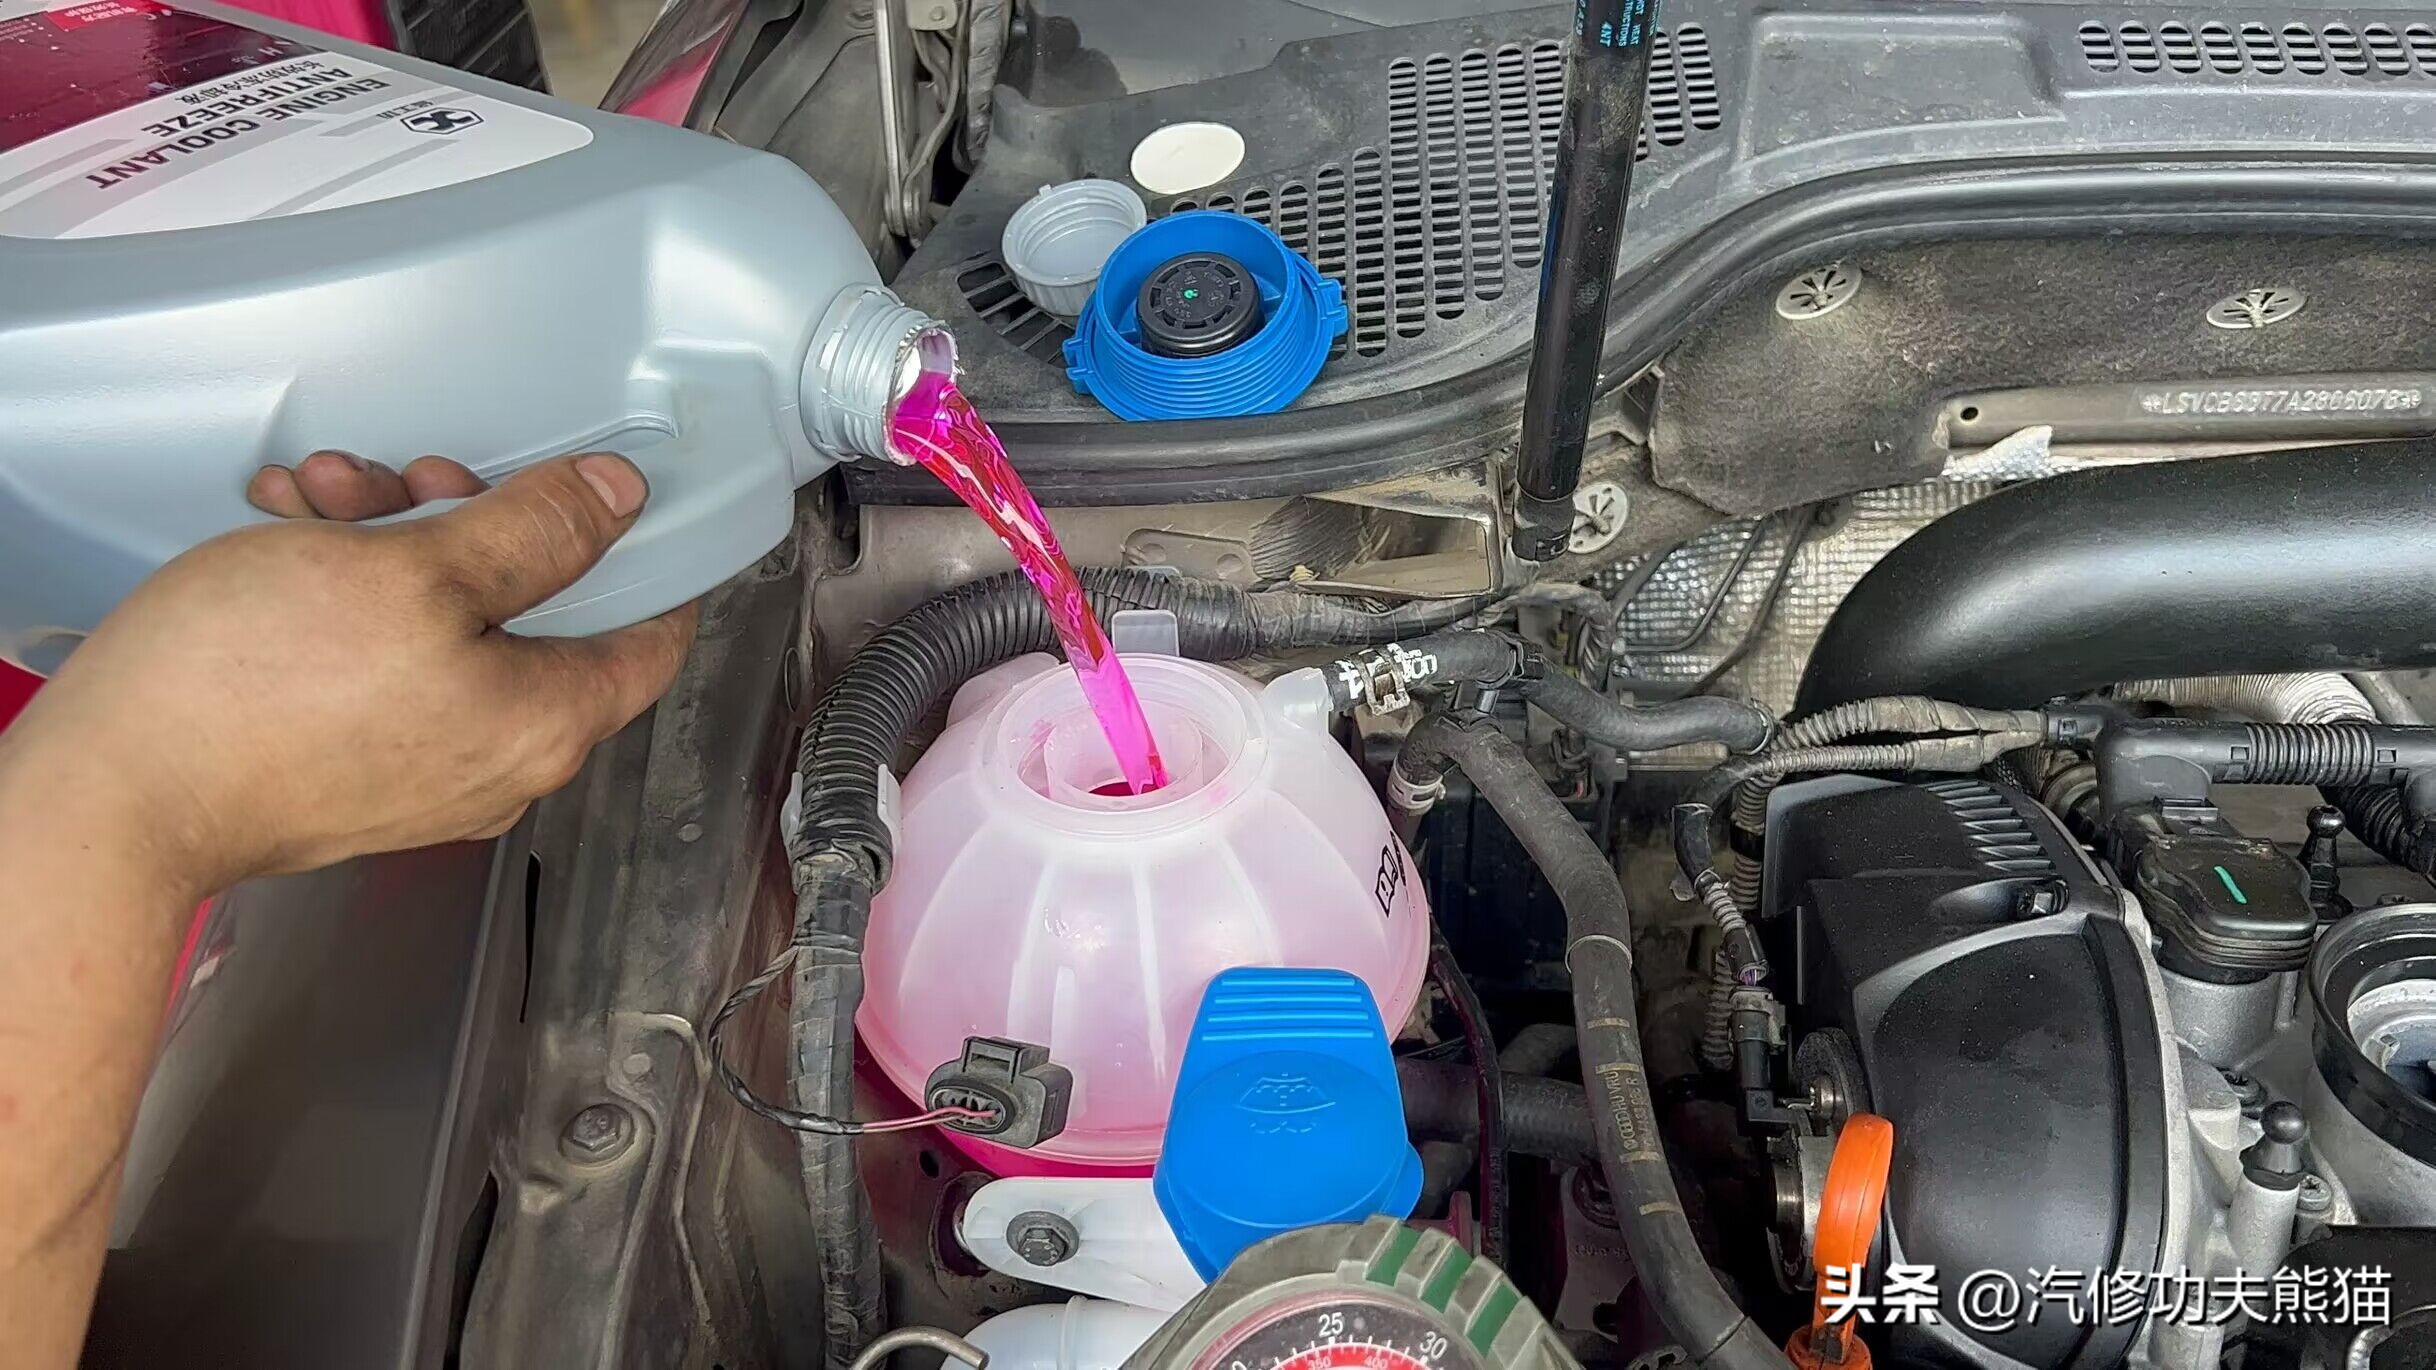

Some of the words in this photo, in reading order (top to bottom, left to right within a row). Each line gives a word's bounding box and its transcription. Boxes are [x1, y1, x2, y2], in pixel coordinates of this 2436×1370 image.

[1618, 0, 1634, 46] TRUCTIONS
[1630, 24, 1641, 45] HEAT
[141, 67, 353, 139] ANTIFREEZE
[264, 78, 392, 122] ENGINE
[85, 119, 261, 189] COOLANT
[1318, 1312, 1344, 1337] 25
[1419, 1330, 1448, 1359] 30
